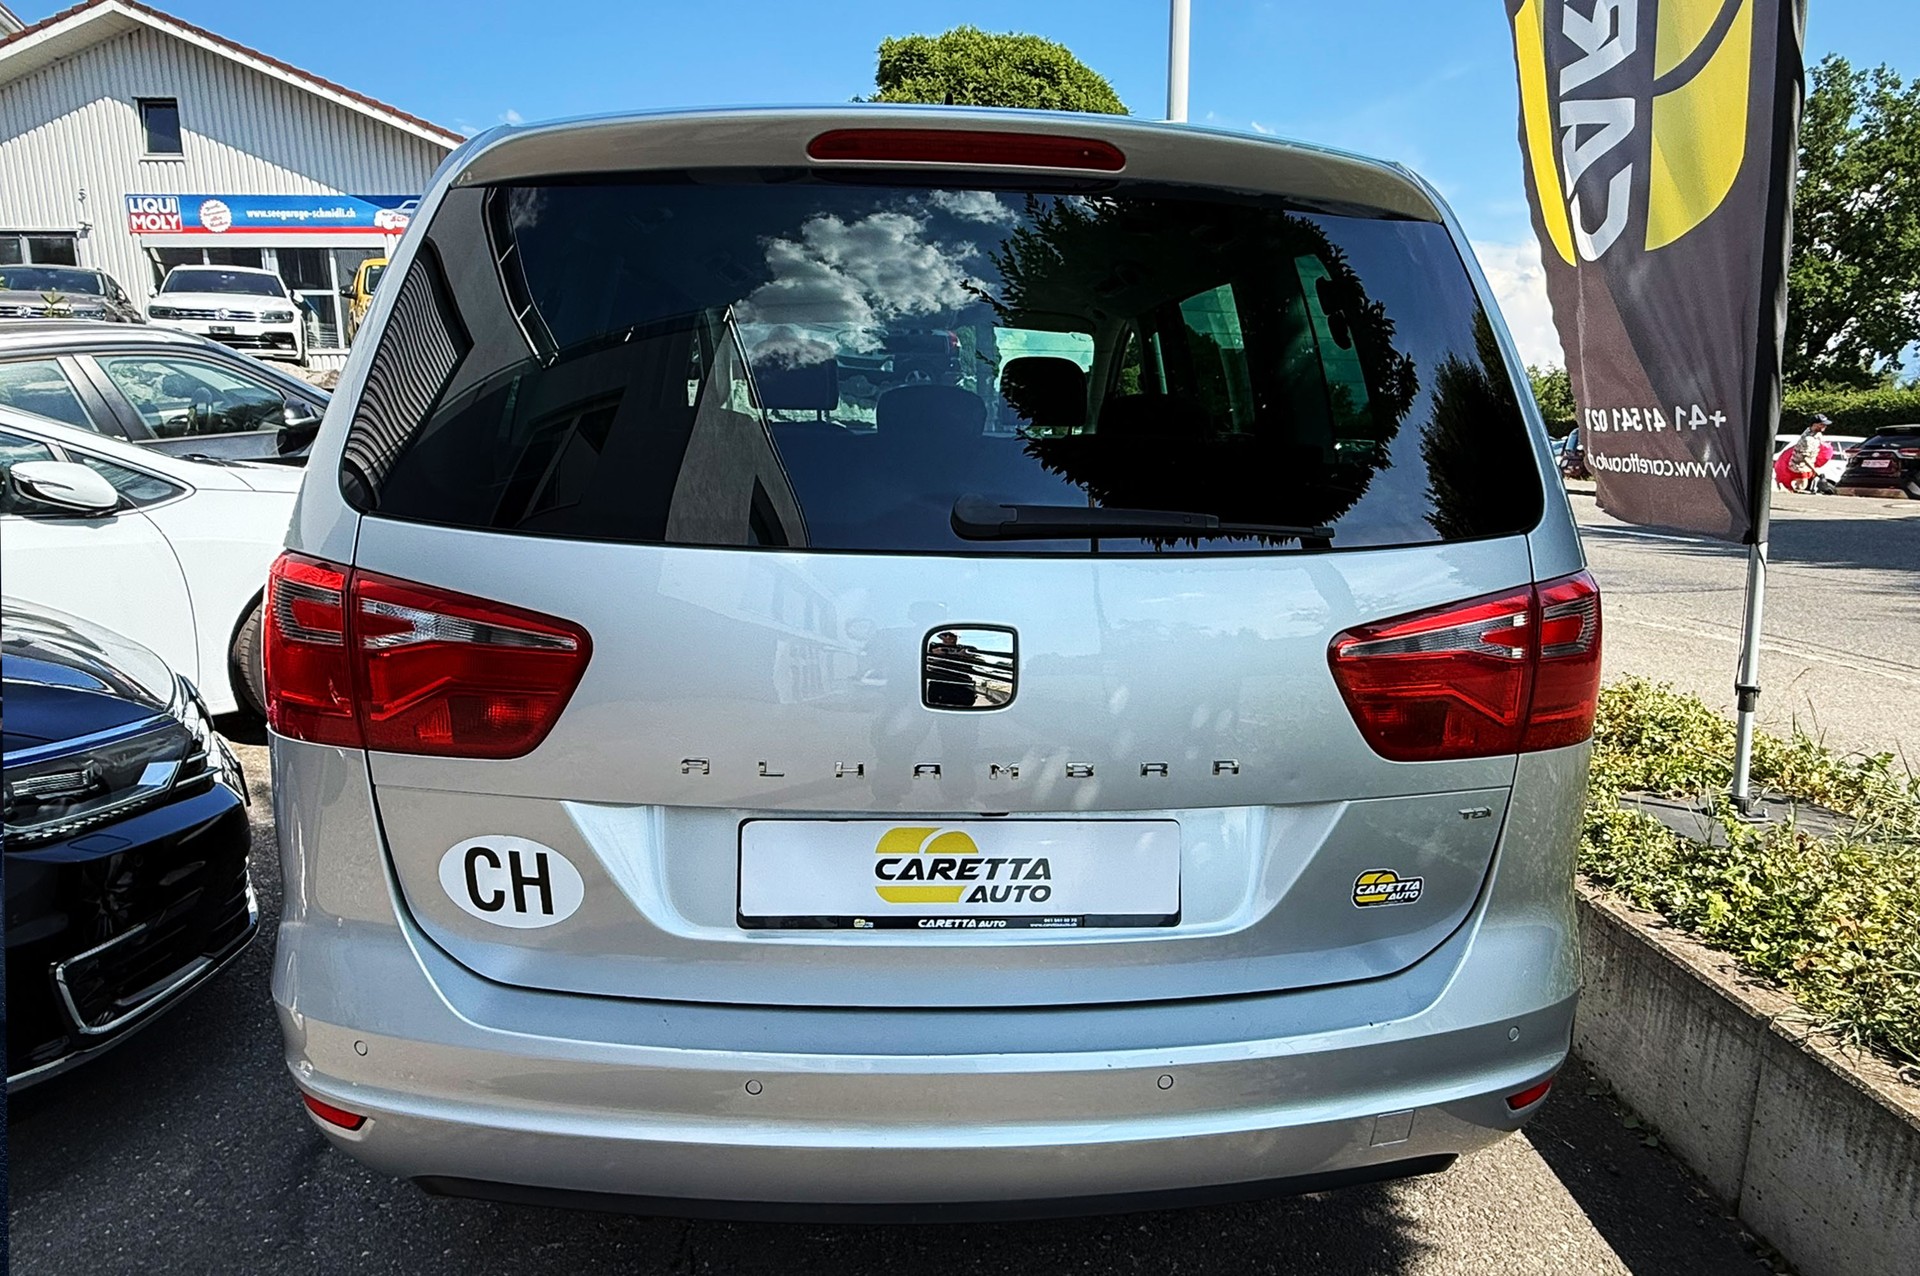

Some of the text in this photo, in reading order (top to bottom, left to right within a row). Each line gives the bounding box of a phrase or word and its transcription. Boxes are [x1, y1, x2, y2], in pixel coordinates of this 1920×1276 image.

[128, 197, 178, 214] LIQUI
[130, 214, 180, 230] MOLY
[246, 207, 356, 221] www.seegarage-schmidli.ch
[681, 757, 1241, 780] ALHAMBRA
[875, 858, 1052, 881] CARETTA
[464, 846, 554, 915] CH
[1356, 881, 1420, 895] CARETTA
[965, 885, 1052, 903] AUTO
[1387, 890, 1419, 901] AUTO
[918, 918, 1007, 928] CARETTA AUTO
